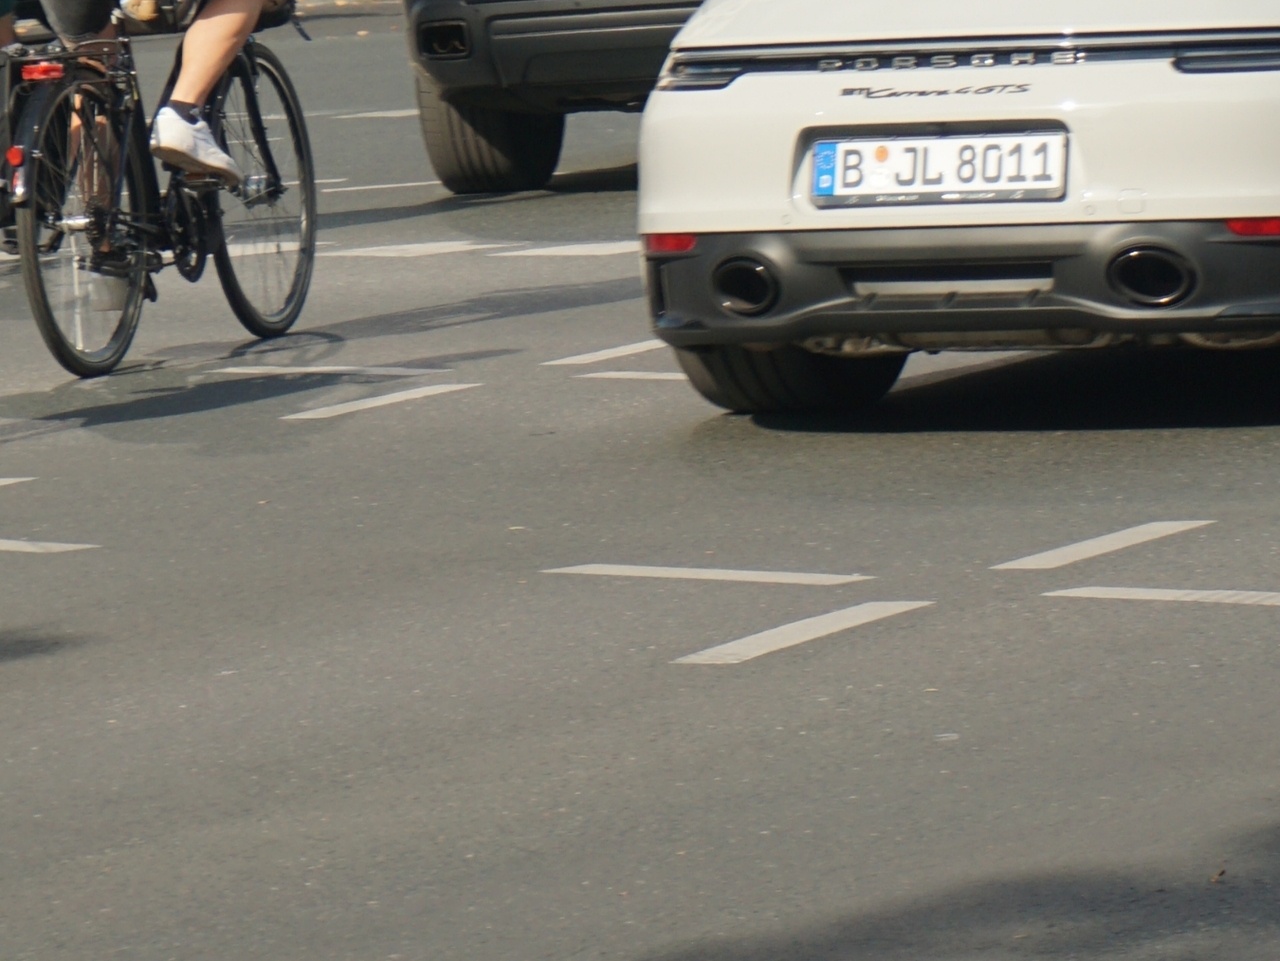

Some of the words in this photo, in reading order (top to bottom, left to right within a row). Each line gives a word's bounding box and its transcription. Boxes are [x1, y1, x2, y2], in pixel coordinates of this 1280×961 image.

[818, 50, 1079, 72] PORSCHE
[974, 83, 1032, 95] GTS
[842, 149, 864, 188] B
[895, 146, 943, 187] JL
[957, 142, 1053, 183] 8011
